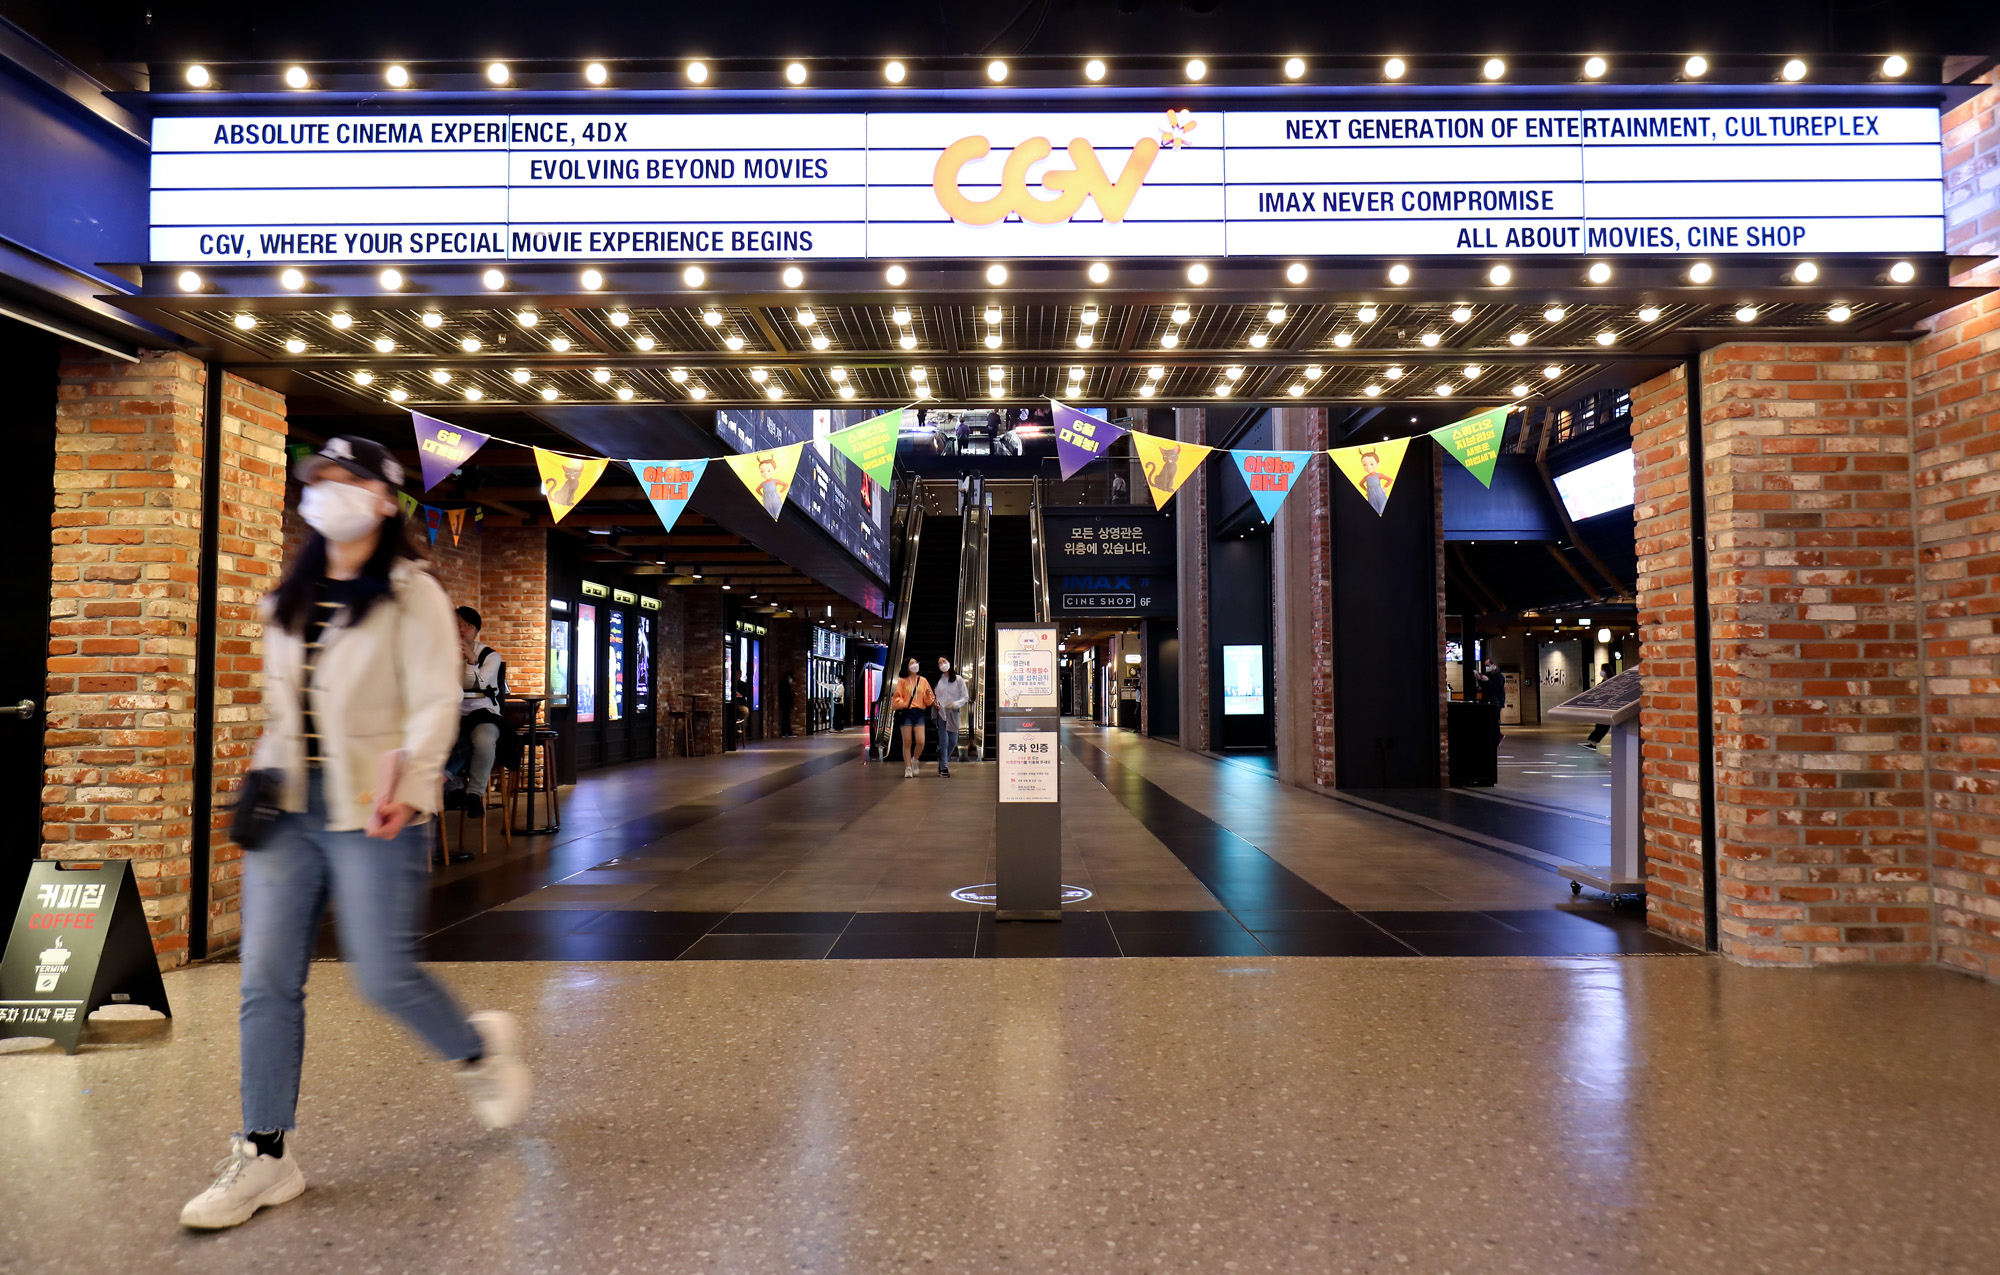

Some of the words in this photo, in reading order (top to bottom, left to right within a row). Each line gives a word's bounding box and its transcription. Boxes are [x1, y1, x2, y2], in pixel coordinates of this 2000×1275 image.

[214, 123, 330, 144] ABSOLUTE
[337, 123, 423, 144] CINEMA
[431, 122, 574, 146] EXPERIENCE,
[582, 122, 628, 142] 4DX
[1286, 119, 1342, 139] NEXT
[1348, 117, 1484, 139] GENERATION
[1491, 117, 1518, 138] OF
[1525, 116, 1716, 138] ENTERTAINMENT,
[1725, 115, 1879, 137] CULTUREPLEX
[530, 159, 639, 180] EVOLVING
[646, 158, 735, 179] BEYOND
[744, 158, 828, 179] MOVIES
[933, 135, 1160, 226] CGV
[1259, 192, 1316, 213] IMAX
[1323, 191, 1394, 212] NEVER
[1401, 190, 1554, 212] COMPROMISE
[199, 234, 251, 258] CGV,
[259, 234, 338, 254] WHERE
[344, 233, 403, 254] YOUR
[409, 232, 505, 254] SPECIAL
[512, 231, 582, 253] MOVIE
[589, 231, 724, 252] EXPERIENCE
[731, 230, 813, 252] BEGINS
[1456, 227, 1498, 248] ALL
[1505, 227, 1580, 248] ABOUT
[1588, 226, 1680, 250] MOVIES,
[1687, 226, 1739, 247] CINE
[1746, 225, 1806, 247] SHOP
[847, 422, 888, 444] 스튜디오
[1072, 419, 1096, 437] 6월
[1452, 418, 1494, 441] 스튜디오
[437, 430, 462, 446] 6월
[850, 433, 891, 455] 지브리의
[1455, 429, 1496, 450] 지브리의
[1244, 456, 1295, 473] 아야와
[643, 466, 694, 483] 아야와
[1250, 474, 1288, 492] 마녀
[649, 483, 688, 500] 마녀
[1071, 527, 1094, 540] 모든
[1098, 527, 1143, 540] 상영관은
[1064, 542, 1098, 555] 위층에
[1102, 542, 1151, 555] 있습니다.
[1063, 575, 1132, 590] IMAX
[1066, 597, 1096, 606] CINE
[1100, 597, 1132, 606] SHOP
[1140, 597, 1151, 607] 6F
[1008, 743, 1027, 753] 주차
[1030, 743, 1049, 753] 인증
[37, 884, 106, 909] 커피집
[29, 913, 97, 929] COFFEE
[35, 965, 69, 974] TERMINI
[22, 1008, 51, 1023] 1시간
[52, 1008, 77, 1022] 무료
